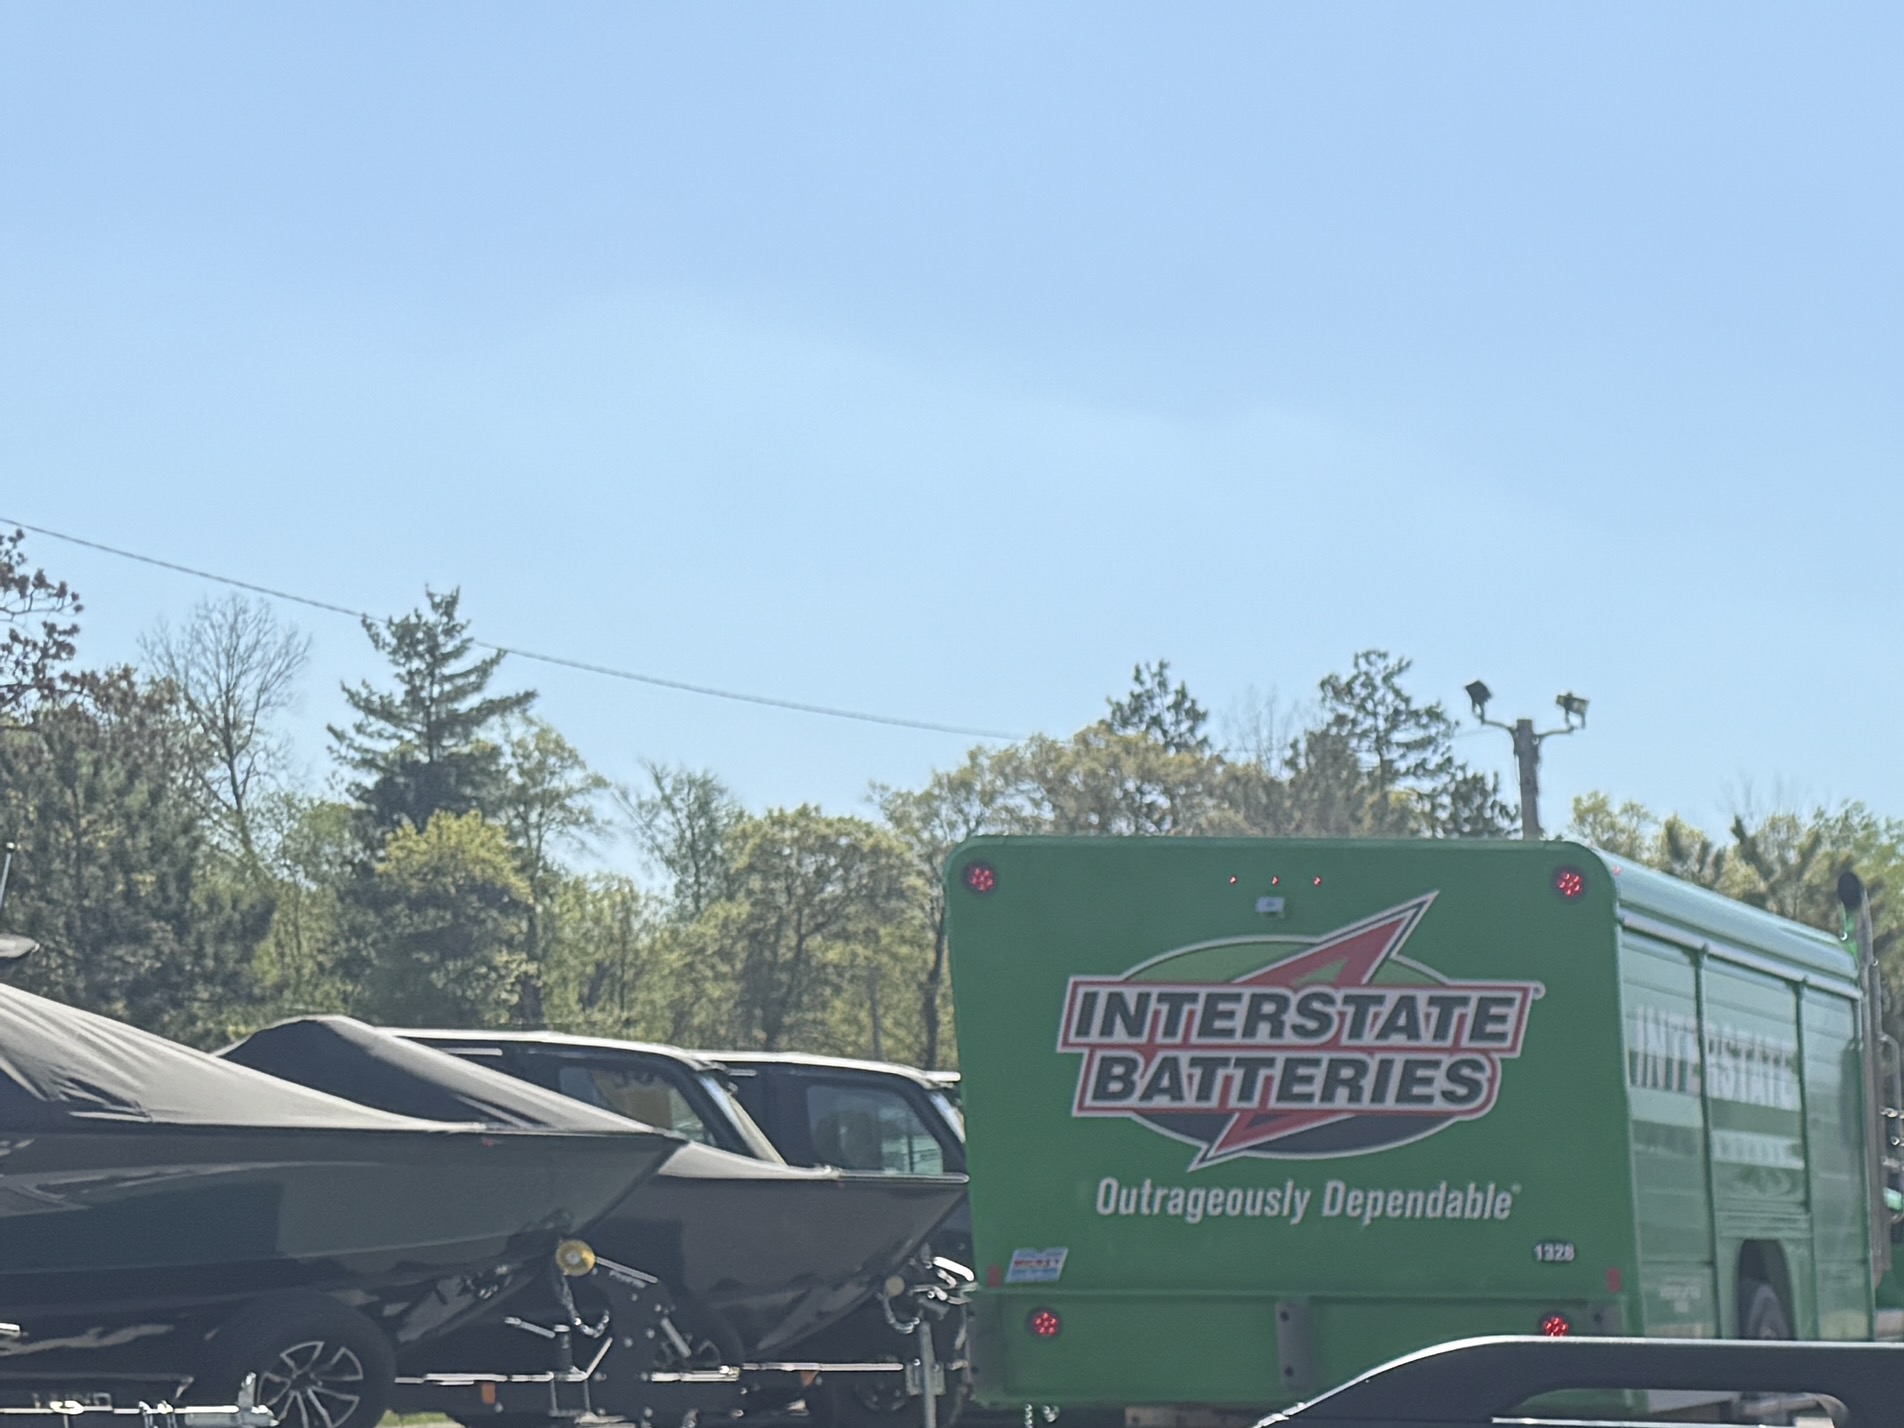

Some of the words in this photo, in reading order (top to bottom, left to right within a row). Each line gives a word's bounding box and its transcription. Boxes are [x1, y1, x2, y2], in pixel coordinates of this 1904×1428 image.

[1074, 990, 1519, 1045] INTERSTATE
[1091, 1054, 1488, 1107] BATTERIES
[1096, 1177, 1311, 1226] Outrageously
[1321, 1180, 1513, 1227] Dependable
